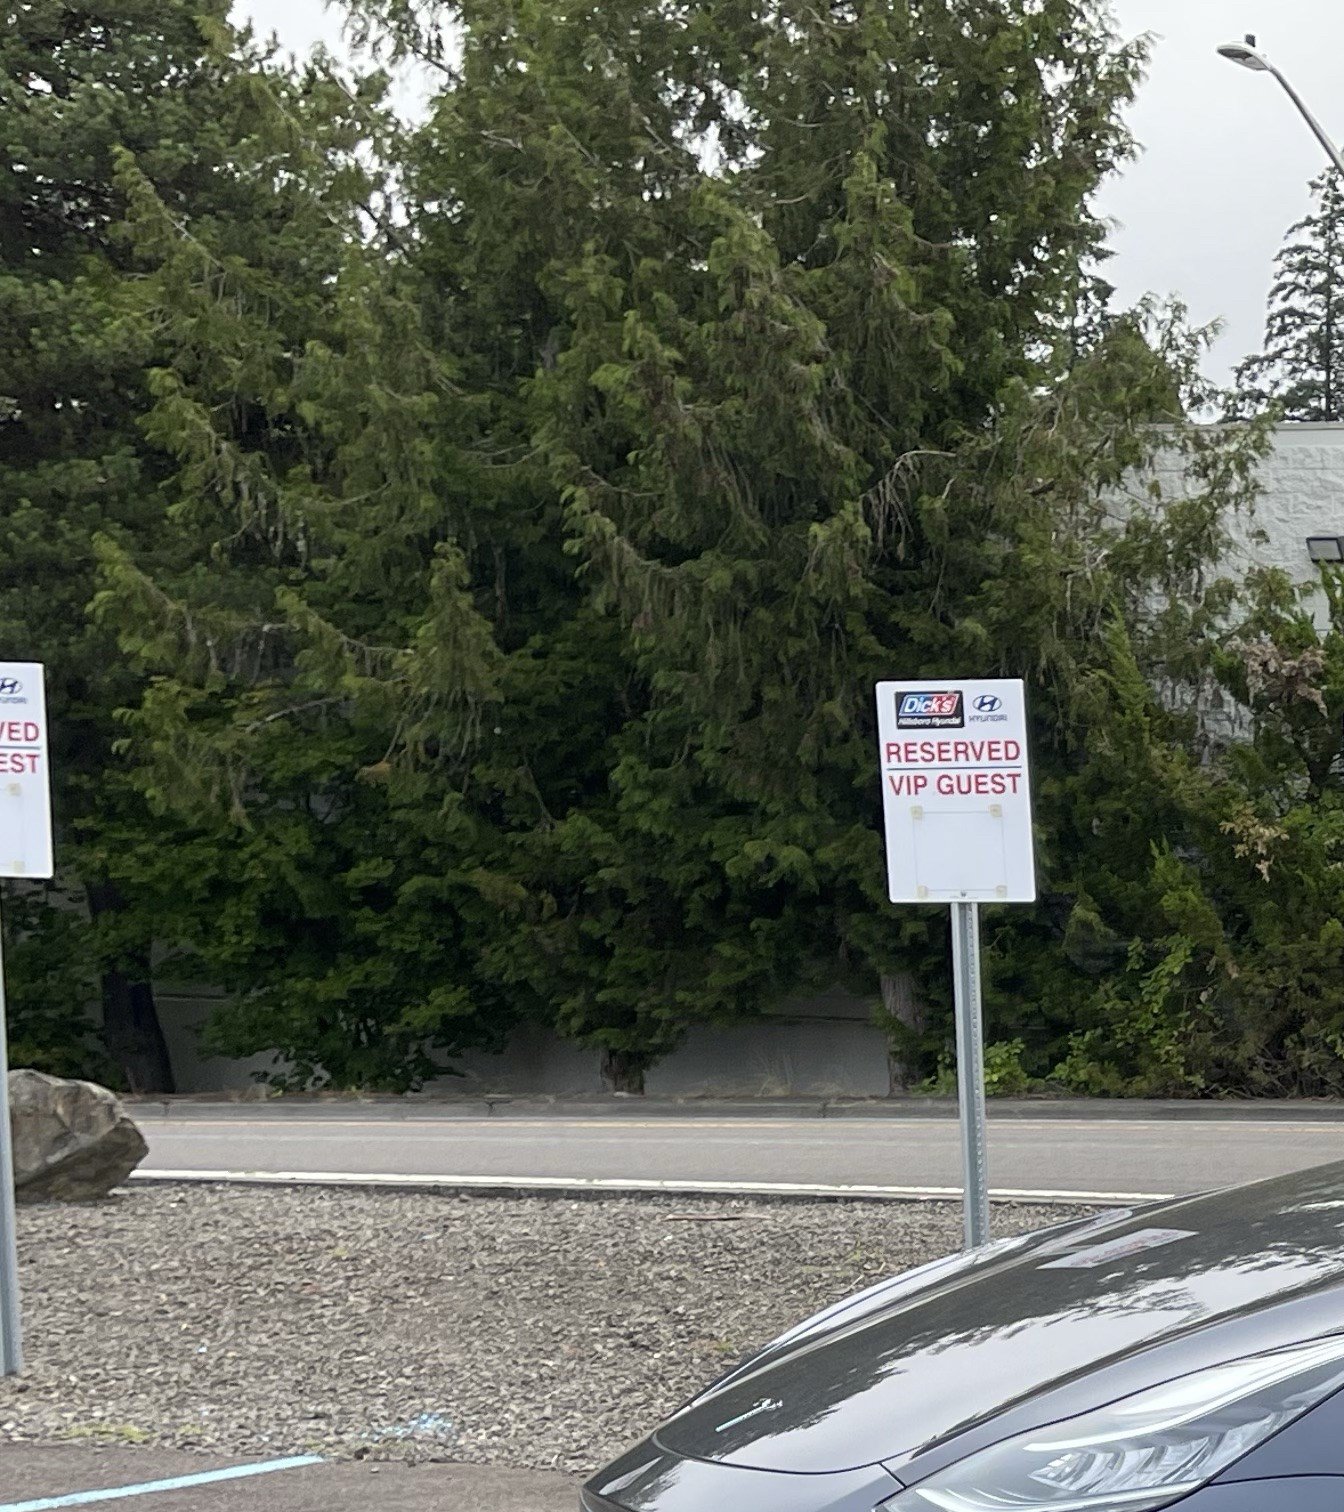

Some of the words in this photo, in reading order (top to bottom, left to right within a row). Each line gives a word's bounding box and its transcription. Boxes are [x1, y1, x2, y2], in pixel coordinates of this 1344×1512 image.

[885, 740, 1021, 763] RESERVED
[888, 775, 928, 796] VIP
[936, 773, 1021, 796] GUEST
